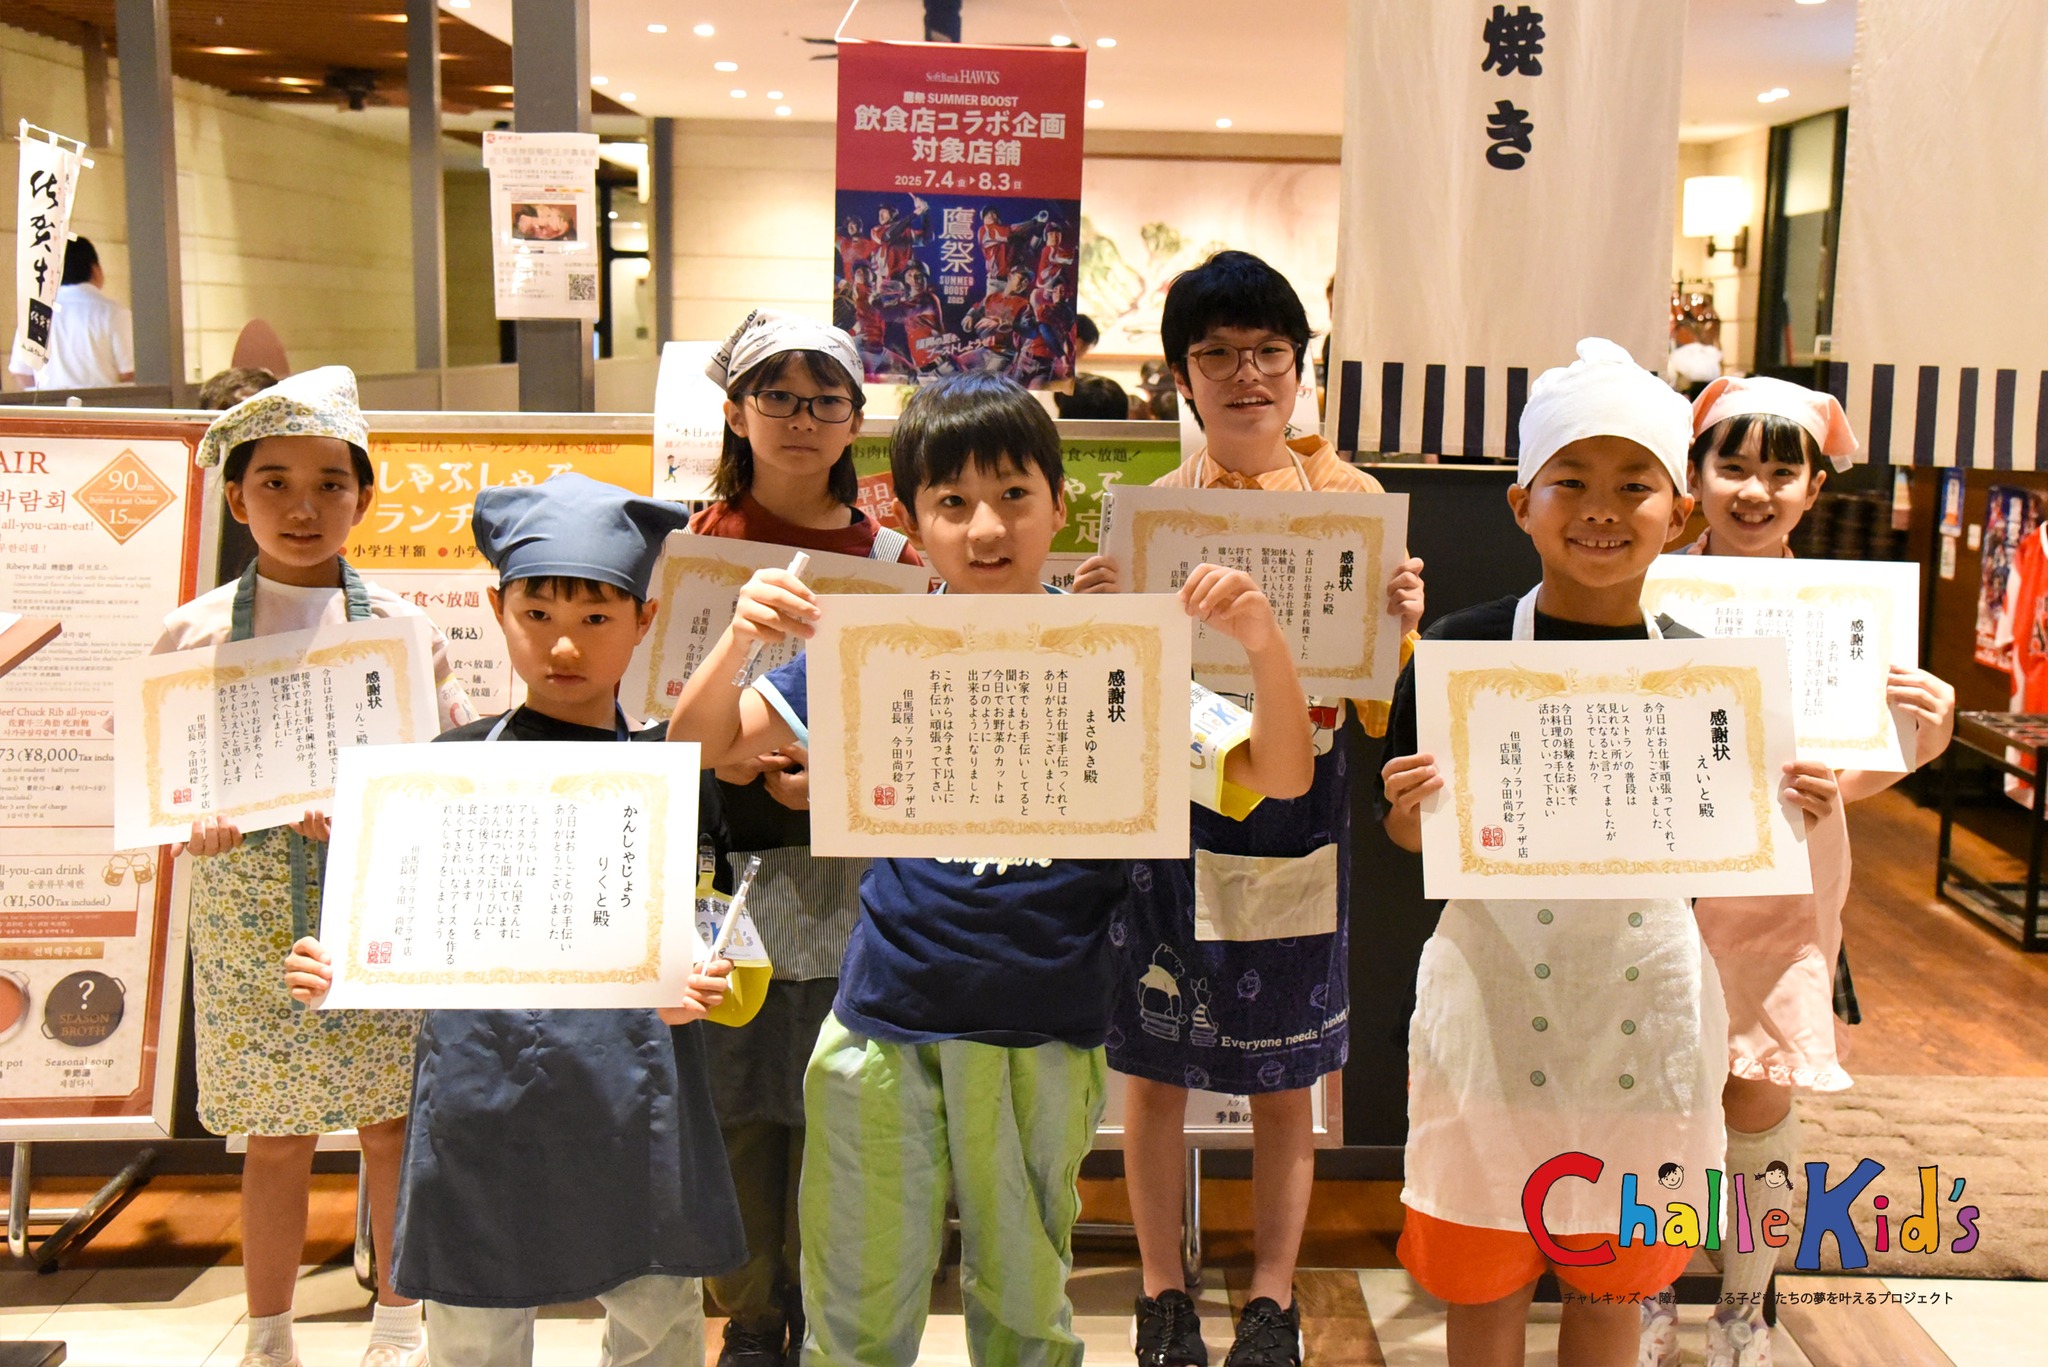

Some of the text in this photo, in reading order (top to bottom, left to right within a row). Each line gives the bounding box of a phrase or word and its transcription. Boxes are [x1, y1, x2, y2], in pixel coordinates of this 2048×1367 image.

[927, 92, 978, 106] SUMMER
[980, 95, 1019, 108] BOOST
[960, 70, 1000, 85] HAWKS
[1481, 5, 1546, 170] 焼き
[854, 104, 1066, 139] 飲食店コラボ企画
[911, 136, 1022, 167] 対象店舗
[894, 175, 922, 186] 2025
[924, 169, 954, 188] 7.4
[978, 173, 1011, 190] 8.3
[938, 206, 976, 274] 鷹祭
[939, 275, 974, 287] SUMMER
[943, 285, 968, 296] BOOST
[1, 518, 94, 533] all-you-can-eat!
[353, 545, 426, 558] 小学生半額
[6, 563, 31, 572] Ribeye
[1170, 570, 1179, 588] 店長
[1285, 548, 1297, 626] 人と関わるお仕事を
[1322, 580, 1335, 615] みお殿
[1338, 550, 1354, 592] 感謝状
[690, 616, 700, 635] 店長
[1301, 549, 1315, 660] 本日はお仕事お疲れ様でした
[1850, 619, 1864, 661] 感謝状
[17, 707, 64, 717] Chuck Rib
[355, 702, 369, 745] りんこ殿
[365, 671, 384, 710] 感謝状
[891, 701, 903, 725] 店長
[981, 670, 992, 743] プロのように
[1005, 669, 1017, 743] 聞いてました
[1107, 668, 1126, 723] 感謝状
[218, 687, 232, 786] ありがとうございました
[903, 689, 916, 818] 但馬屋ソラリアプラザ店
[930, 669, 942, 804] お手伝い頑張って下さい
[943, 670, 955, 804] これからは今まで以上に
[968, 669, 980, 805] 出来るようになりました
[993, 669, 1006, 804] 今日でお野菜のカットは
[1019, 669, 1031, 817] お家でもお手伝いしてると
[1044, 669, 1056, 805] ありがとうございました
[1056, 669, 1069, 816] 本日はお仕事手伝っくれて
[1084, 709, 1098, 784] まさゆき殿
[1500, 742, 1510, 765] 店長
[1538, 703, 1556, 818] 活かしていって下さい
[1550, 703, 1566, 807] お料理のお手伝いに
[1561, 703, 1578, 807] 今日の経験をお家で
[1608, 703, 1623, 772] 見れない所が
[1621, 703, 1637, 806] レストランの普段は
[1643, 703, 1663, 830] ありがとうございました
[1709, 708, 1731, 762] 感謝状
[1510, 731, 1529, 859] 但馬屋ソラリアプラザ店
[1597, 703, 1617, 842] 気になると言ってましたが
[1654, 702, 1675, 852] 今日はお仕事頑張ってくれて
[1696, 754, 1715, 818] えいと殿
[56, 864, 85, 876] drink
[436, 804, 453, 940] れんしゅうをしましょう
[463, 804, 477, 901] 食べてもらいます
[473, 804, 489, 940] この後アイスクリームを
[485, 804, 502, 927] がんばったごほうびに
[498, 804, 514, 940] なりたいと聞いています
[510, 804, 526, 940] アイスクリーム屋さんに
[526, 804, 540, 877] しょうらいは
[549, 804, 565, 940] ありがとうございました
[620, 805, 638, 909] かんしゃじょう
[446, 804, 465, 965] 丸くてきれいなアイスを作る
[561, 804, 578, 951] 今日はおしごとのお手伝い
[592, 857, 611, 928] りくと殿
[59, 1013, 110, 1024] SEASON
[61, 1025, 106, 1036] BROTH
[1220, 1035, 1283, 1050] Everyone
[1285, 1029, 1318, 1045] needs
[45, 1057, 88, 1067] Seasonal
[90, 1057, 115, 1069] soup
